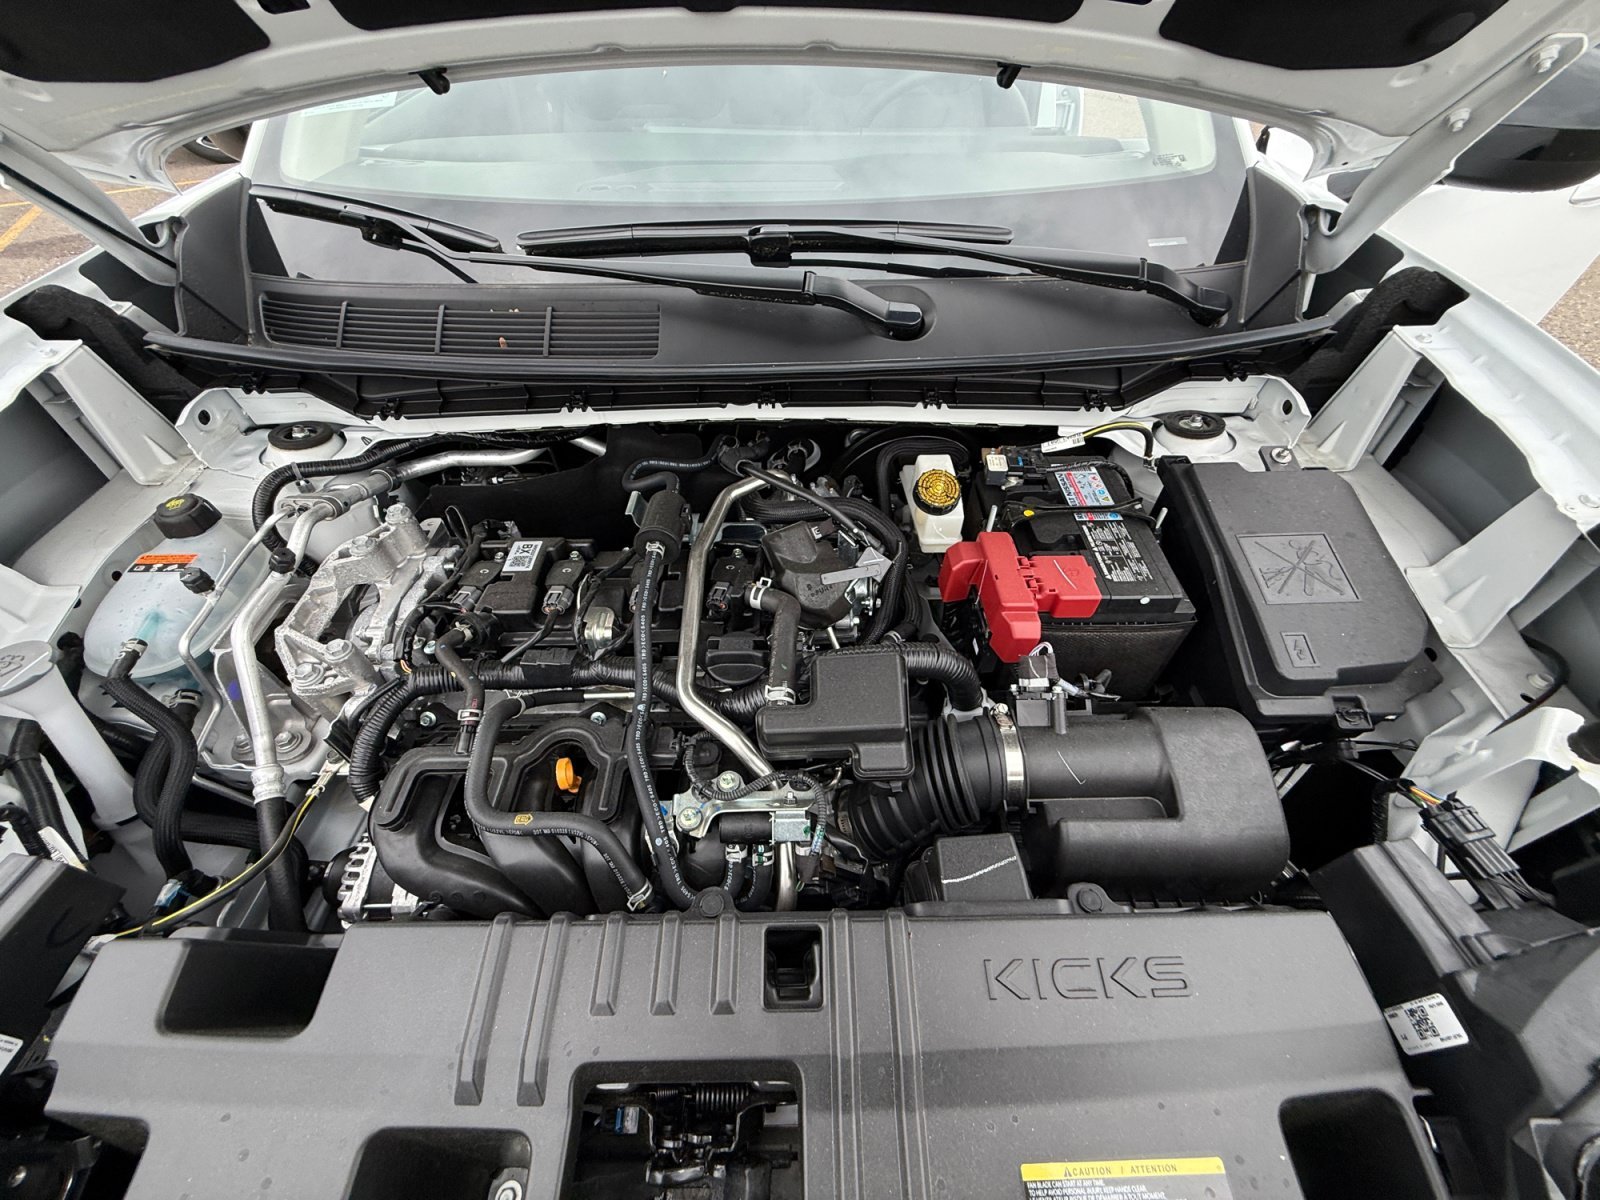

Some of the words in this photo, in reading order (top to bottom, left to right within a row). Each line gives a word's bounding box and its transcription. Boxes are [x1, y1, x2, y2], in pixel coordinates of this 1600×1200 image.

[1057, 473, 1072, 497] NISSAN
[520, 544, 533, 554] BX
[983, 955, 1192, 1001] KICKS
[1072, 1166, 1112, 1176] CAUTION
[1130, 1164, 1178, 1174] ATTENTION
